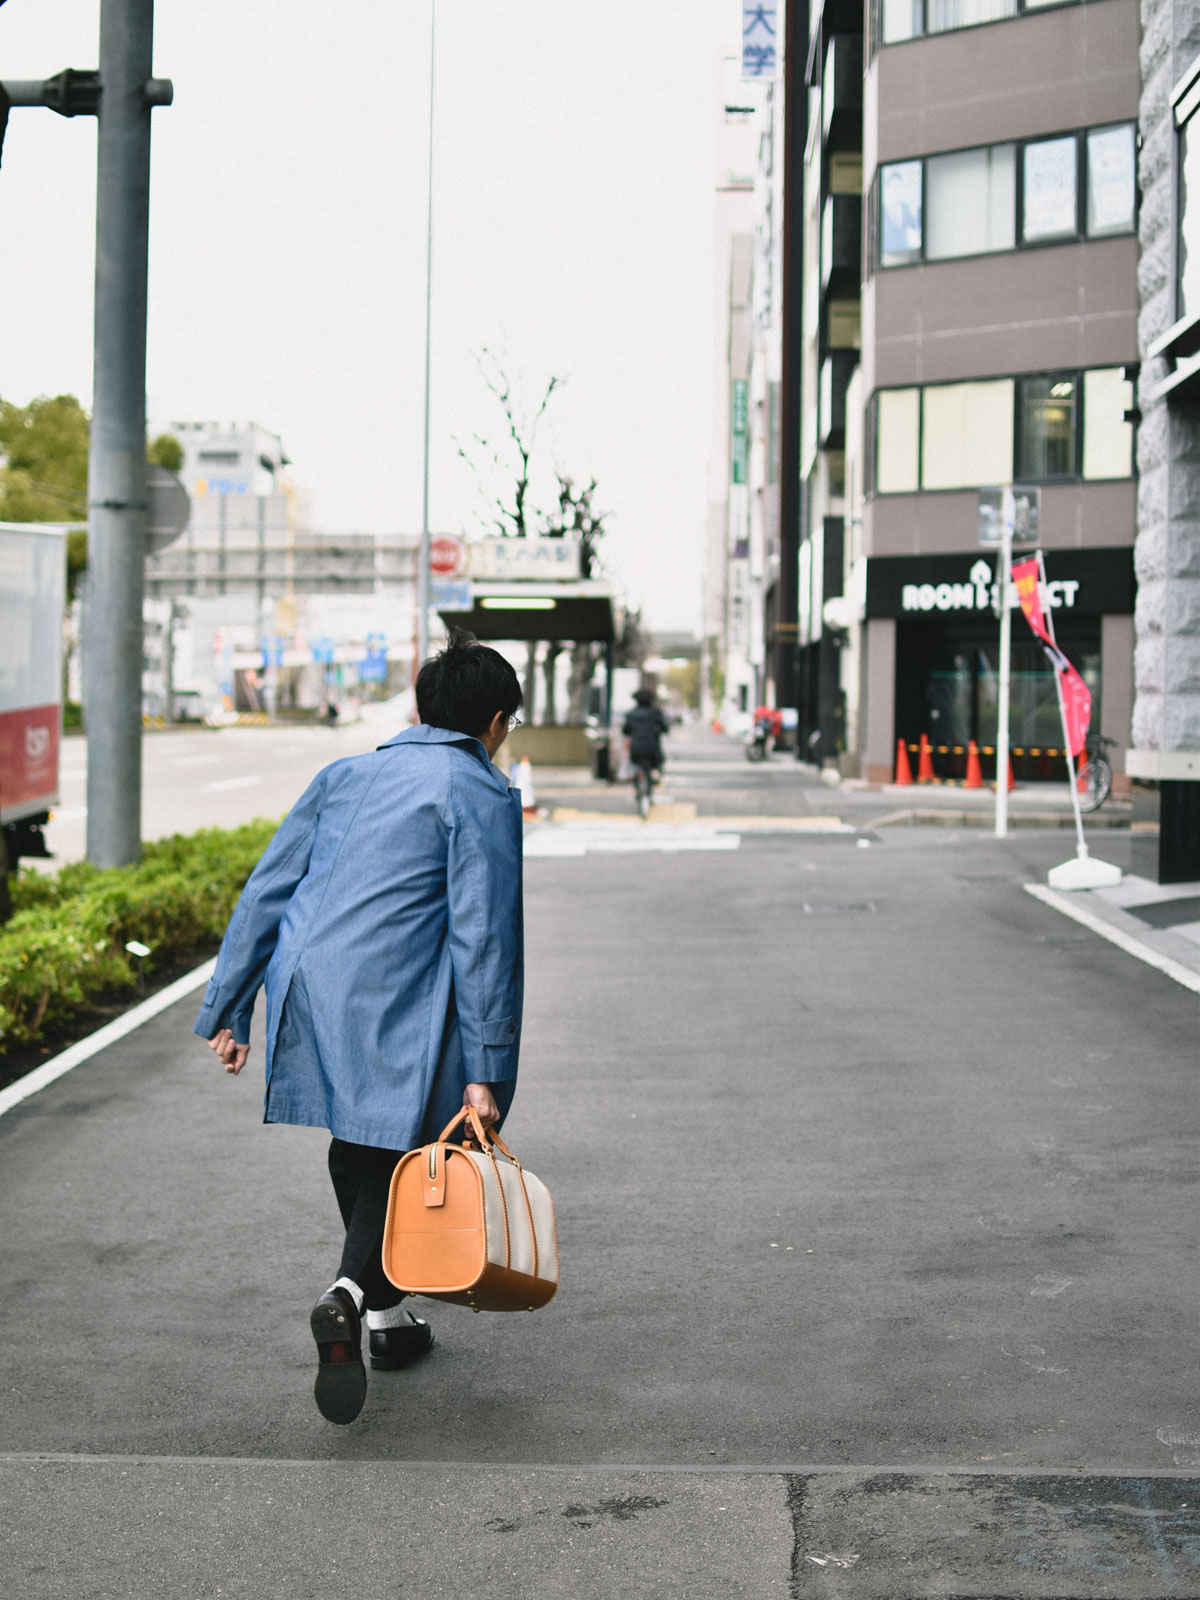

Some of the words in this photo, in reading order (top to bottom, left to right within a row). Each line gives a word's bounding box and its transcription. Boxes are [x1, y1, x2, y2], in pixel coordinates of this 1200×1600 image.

[743, 3, 776, 76] 大学
[902, 583, 974, 611] ROOM
[990, 580, 1080, 609] SCT
